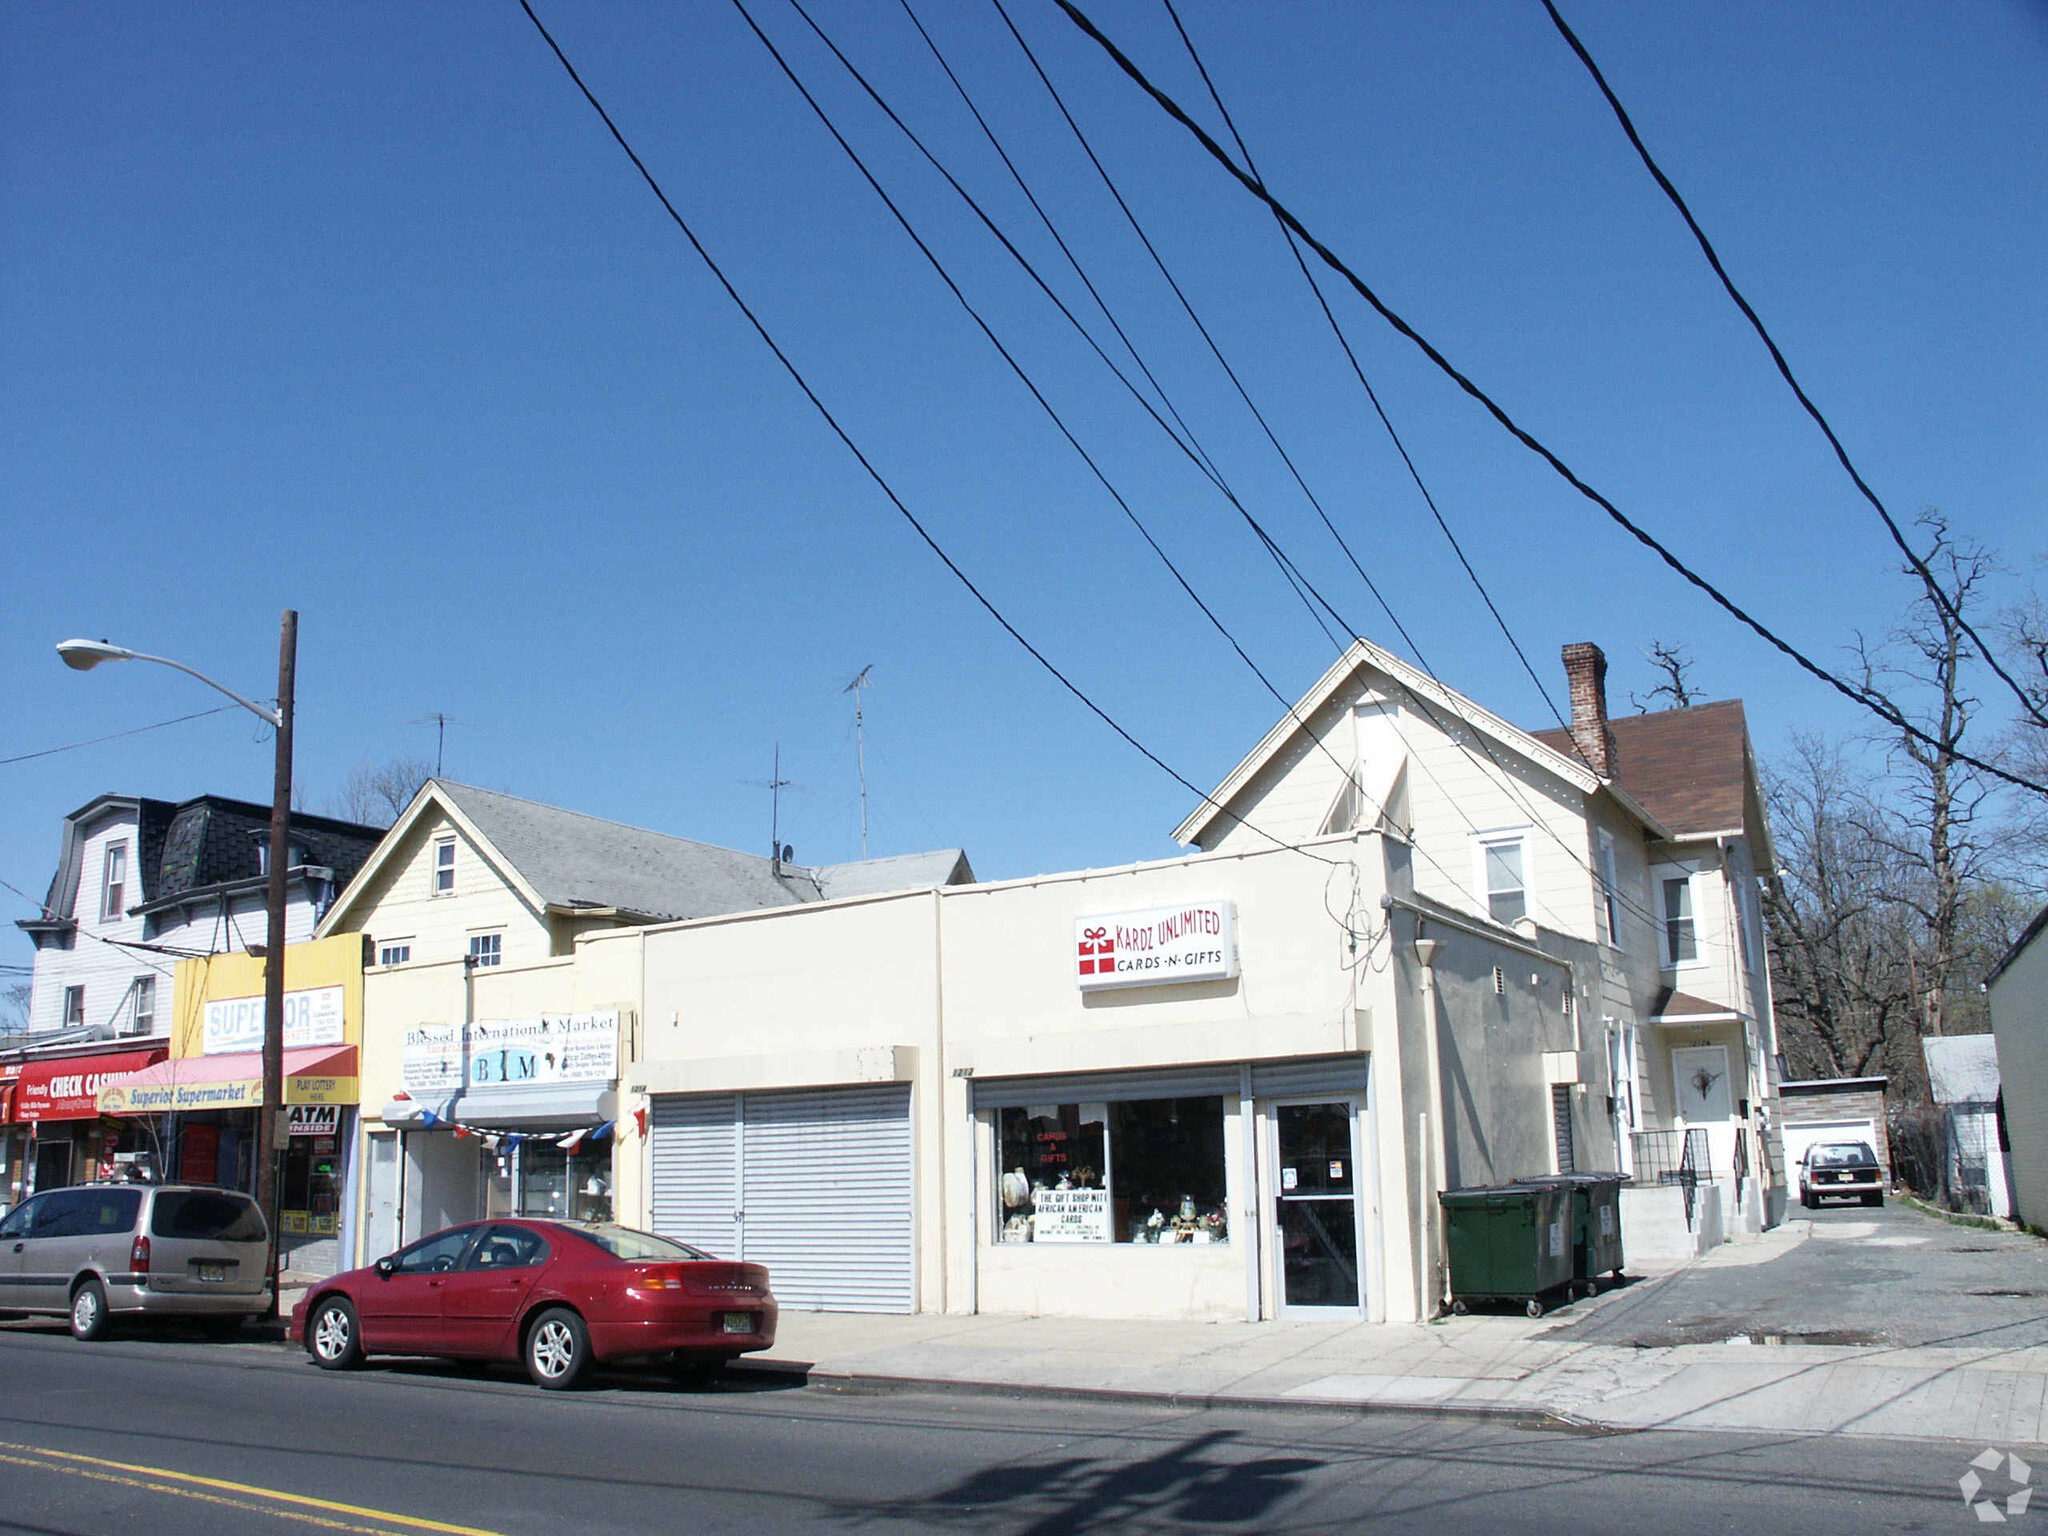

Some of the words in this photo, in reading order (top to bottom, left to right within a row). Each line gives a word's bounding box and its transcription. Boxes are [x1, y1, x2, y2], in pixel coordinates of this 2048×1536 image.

[1116, 925, 1154, 951] KARDZ
[1157, 909, 1220, 945] UNLIMITED
[1117, 956, 1160, 972] CARDS
[1184, 950, 1222, 966] GIFTS
[210, 996, 310, 1037] SUPEOR
[406, 1028, 454, 1045] Blessed
[461, 1020, 550, 1043] International
[558, 1017, 614, 1034] Market
[26, 1084, 49, 1097] Friendly
[50, 1075, 83, 1098] CHECK
[130, 1087, 175, 1108] Superior
[176, 1083, 246, 1104] Supermarket
[289, 1106, 336, 1123] ATM
[289, 1124, 332, 1132] INSIDE
[1036, 1131, 1068, 1142] CARDS
[1041, 1152, 1067, 1162] GIFTS
[1040, 1193, 1052, 1203] THE
[1055, 1193, 1070, 1203] GIFT
[1072, 1193, 1090, 1203] SHOP
[1038, 1204, 1066, 1213] AFRICAN
[1068, 1203, 1103, 1213] AMERICAN
[1060, 1214, 1083, 1224] CARDS
